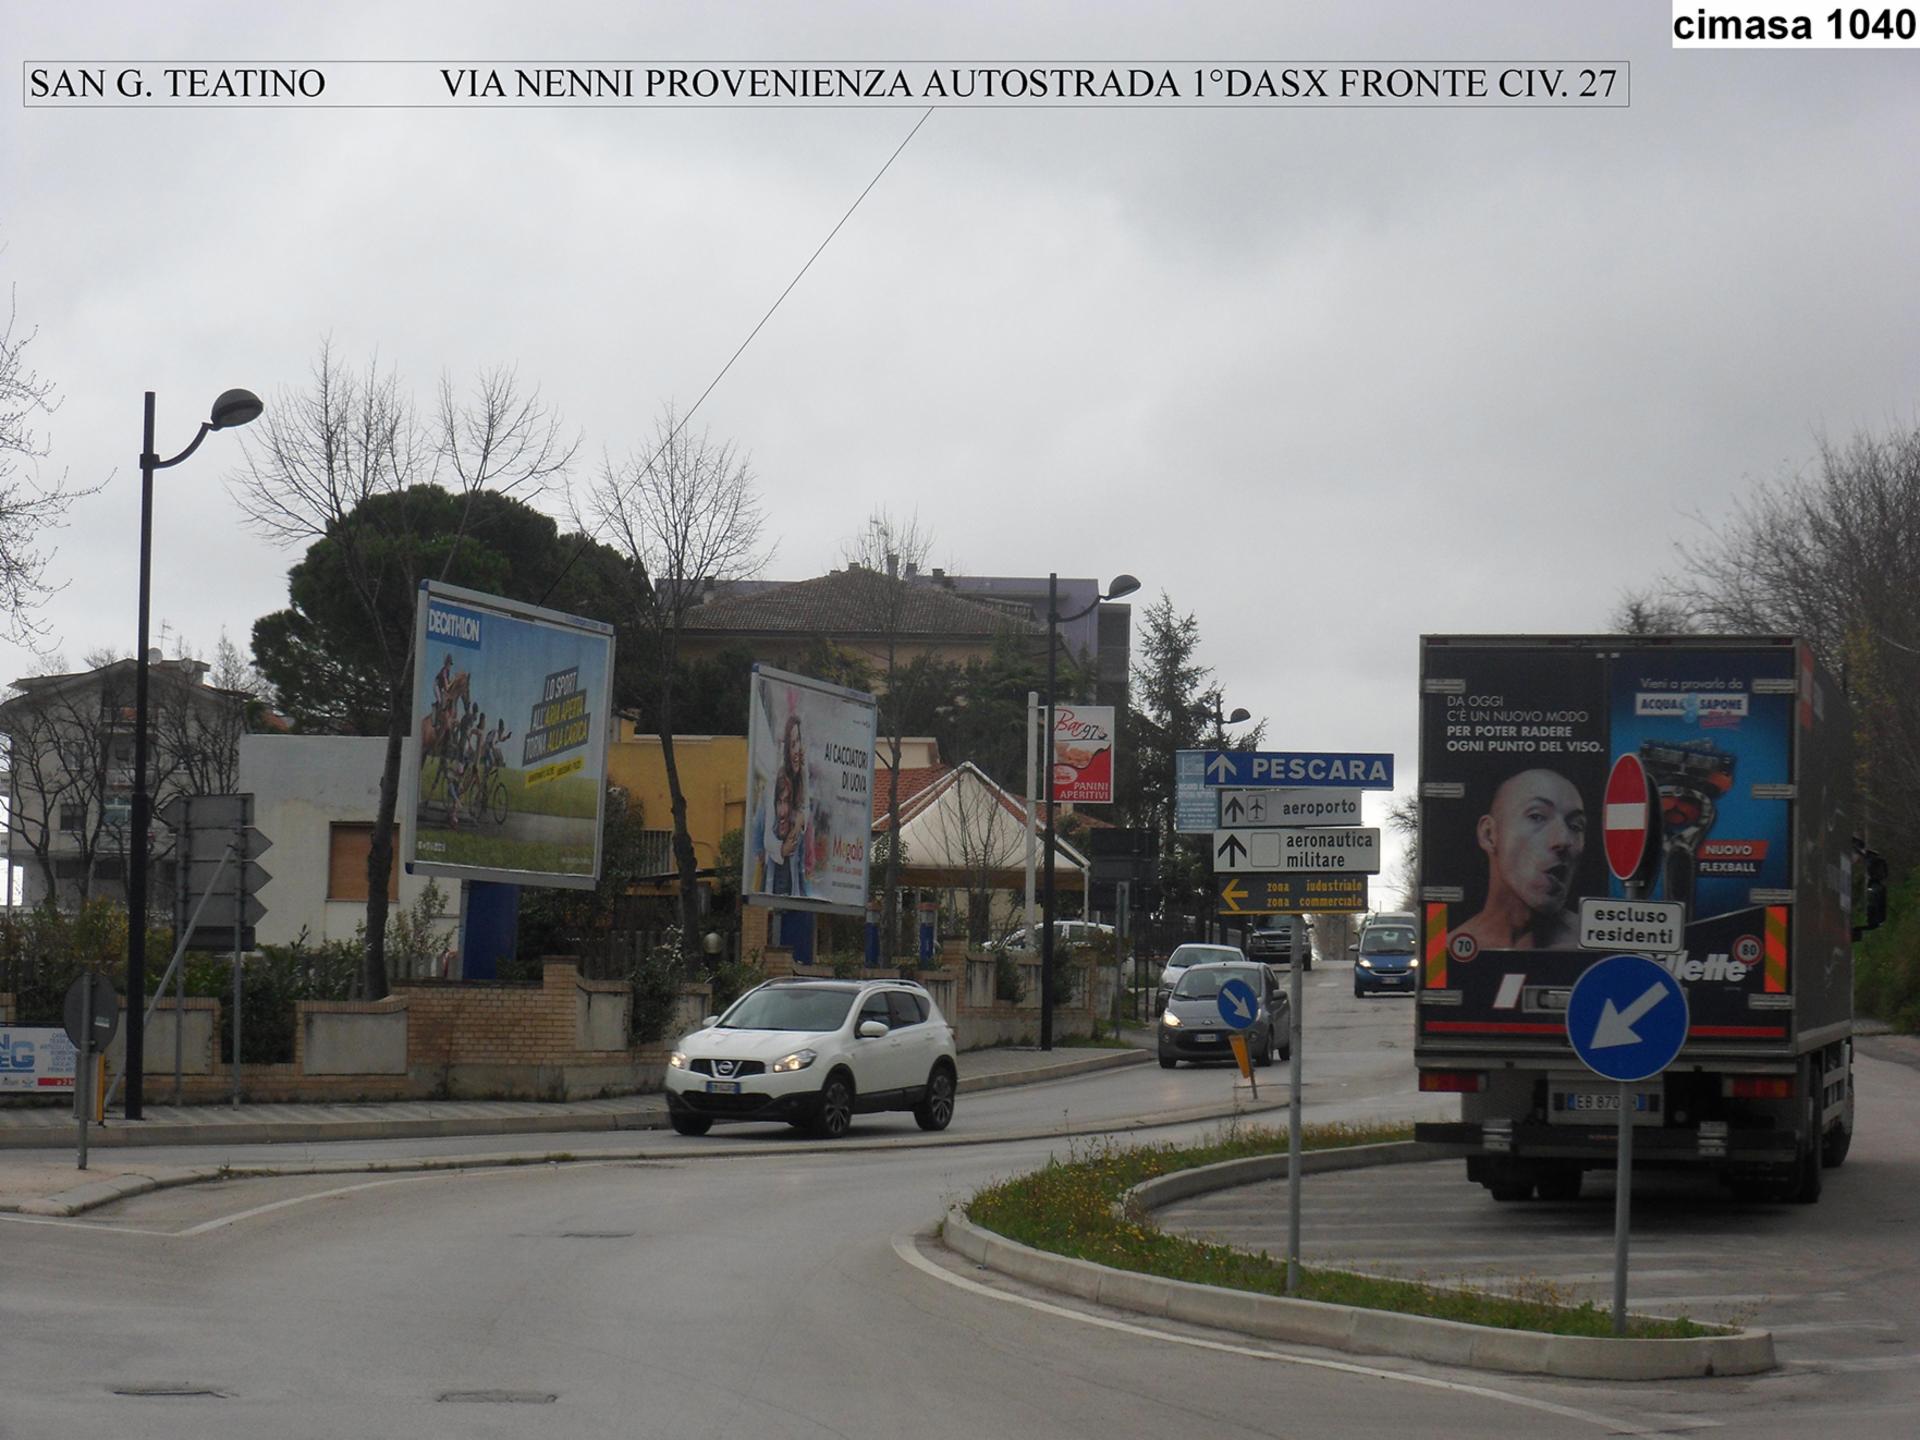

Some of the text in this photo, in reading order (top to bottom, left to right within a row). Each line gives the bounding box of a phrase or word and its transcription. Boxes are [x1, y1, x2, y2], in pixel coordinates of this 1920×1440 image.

[429, 609, 480, 642] DECATHLON
[556, 671, 577, 698] SPORT
[1640, 679, 1668, 689] Vieni
[1681, 678, 1725, 691] provarlo
[1728, 678, 1743, 689] da
[1447, 695, 1504, 707] DA OGGI
[1641, 698, 1742, 711] ACQUA SAPONE
[1446, 708, 1589, 722] C'È UN NUOVO MODO
[1447, 725, 1573, 737] PER POTER RADERE
[1446, 740, 1605, 752] OGNI PUNTO DEL VISO.
[824, 743, 868, 769] AI CACCIATORI
[1252, 758, 1388, 781] PESCARA
[842, 771, 867, 792] DI UOVA
[1074, 782, 1108, 790] PANINI
[1060, 790, 1108, 800] APERITIVI
[1283, 799, 1356, 816] aeroporto
[1286, 832, 1373, 848] aeronautica
[1705, 845, 1752, 855] NUOVO
[1286, 853, 1345, 867] militare
[1699, 862, 1756, 872] FLEXBALL
[1267, 879, 1362, 892] zona industriale
[1267, 894, 1362, 907] zona commerciale
[1594, 907, 1668, 923] escluso
[1587, 927, 1673, 944] residenti
[1457, 940, 1472, 952] 70
[1742, 943, 1757, 956] 80
[1577, 1095, 1593, 1108] EB
